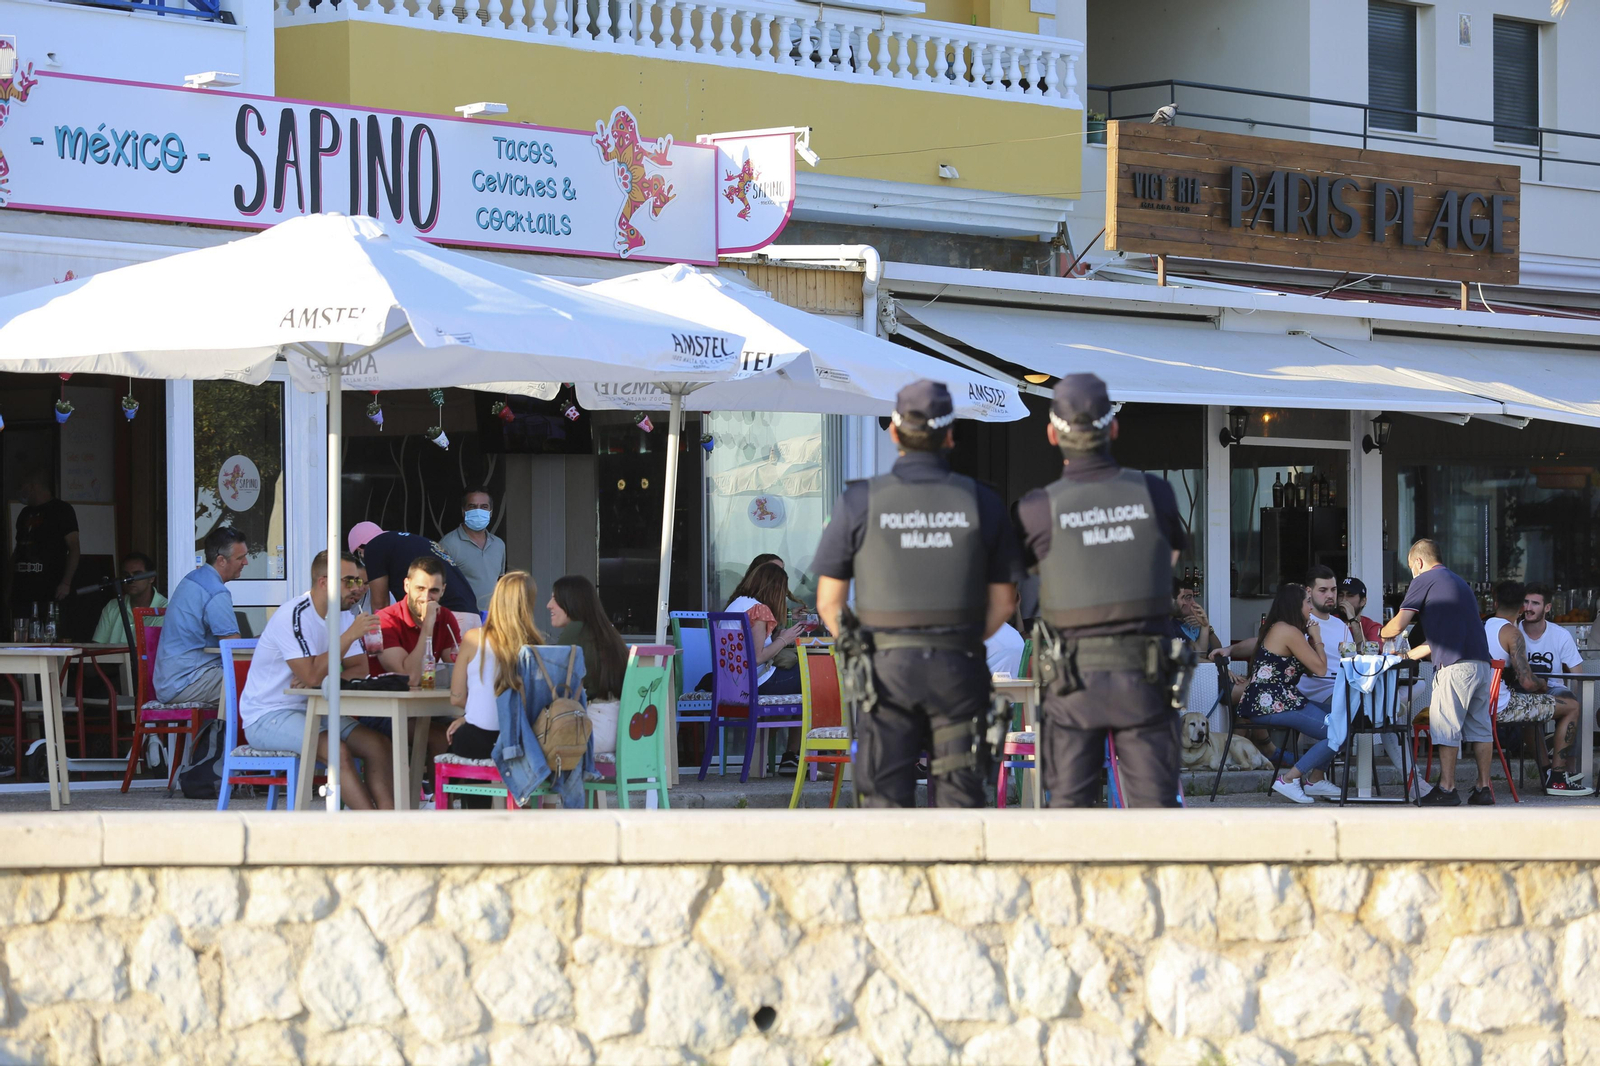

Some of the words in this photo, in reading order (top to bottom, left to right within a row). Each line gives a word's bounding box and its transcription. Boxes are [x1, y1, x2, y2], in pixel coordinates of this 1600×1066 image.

[234, 103, 441, 234] SAPINO
[471, 169, 558, 199] Ceviches
[562, 176, 577, 201] &
[1229, 165, 1361, 239] PARIS
[1373, 182, 1516, 254] PLAGE
[671, 332, 734, 359] AMSTEL
[968, 381, 1006, 408] AMSTEL
[239, 478, 259, 489] SAPINO
[880, 509, 928, 529] POLICÍA
[928, 511, 970, 528] LOCAL
[1059, 506, 1108, 530] POLICÍA
[1106, 503, 1150, 523] LOCAL
[900, 529, 954, 549] MÁLAGA
[1082, 525, 1135, 546] MÁLAGA
